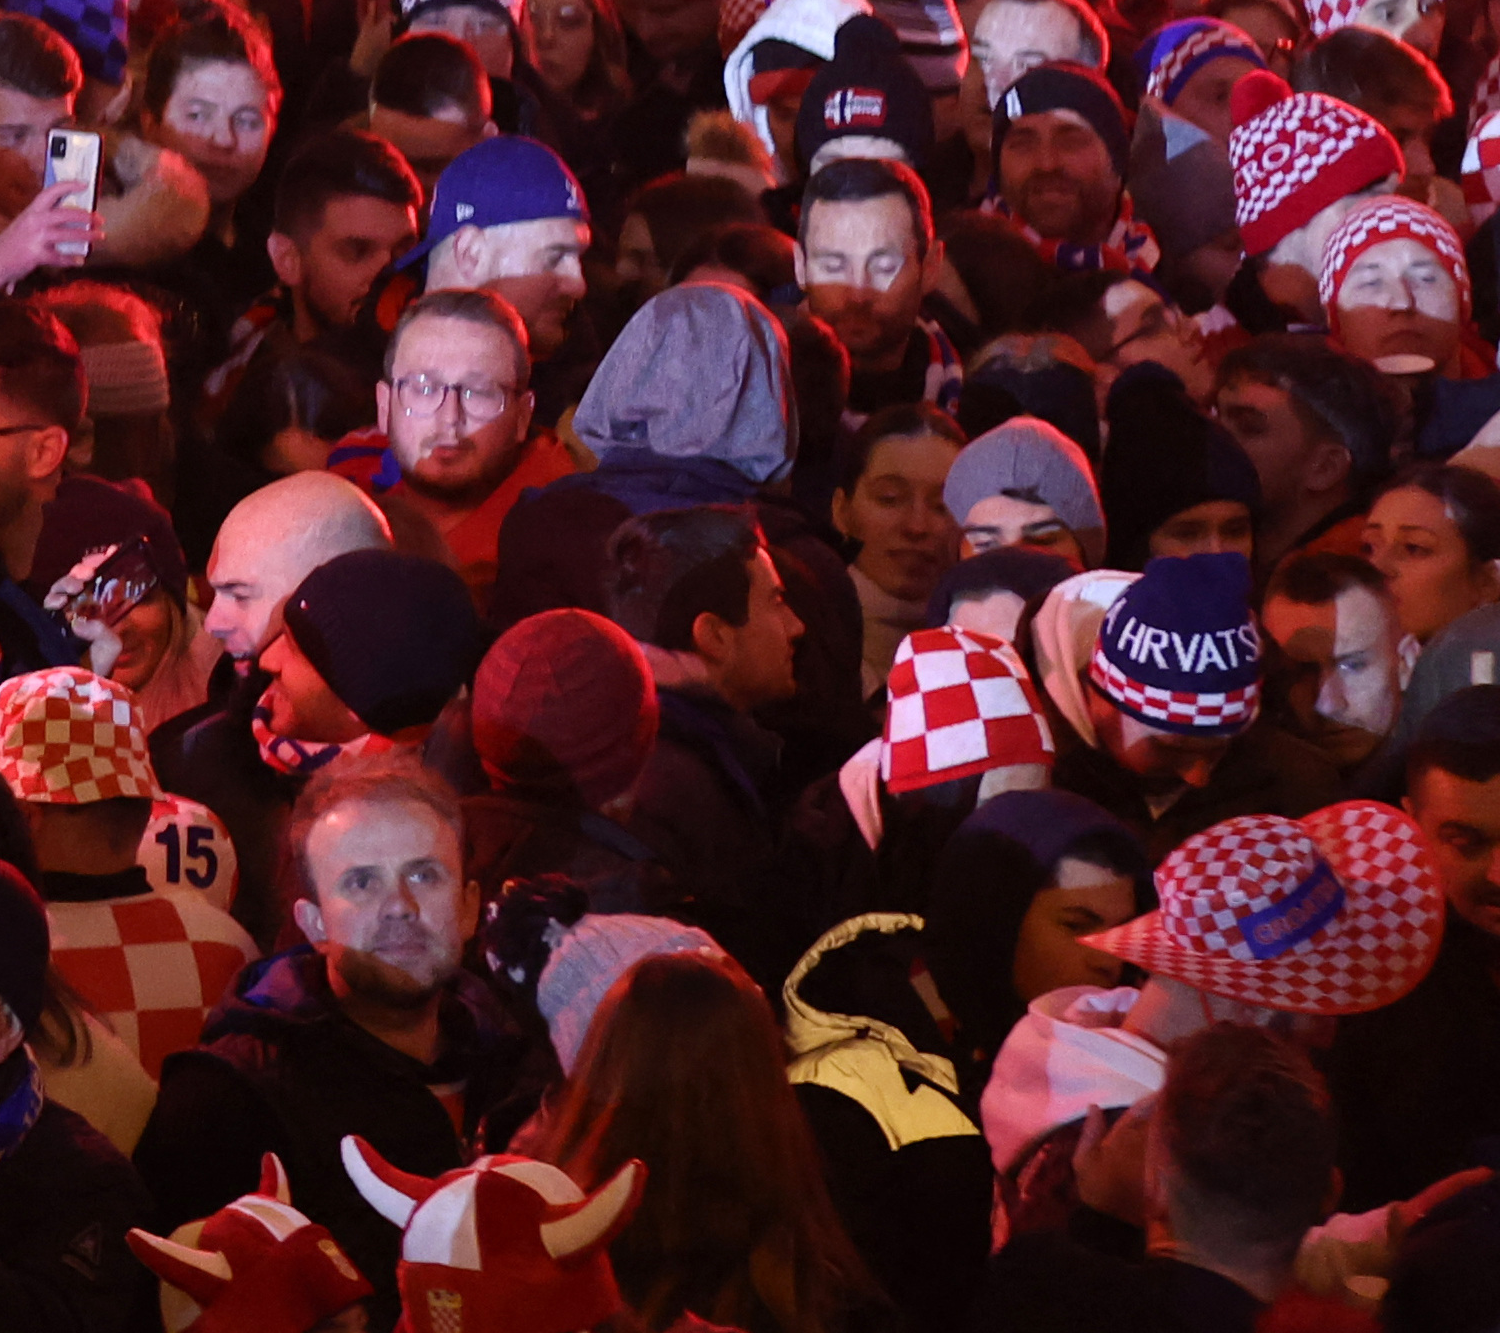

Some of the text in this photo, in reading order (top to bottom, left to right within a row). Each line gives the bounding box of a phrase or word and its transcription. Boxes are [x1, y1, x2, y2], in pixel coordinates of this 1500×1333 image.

[1233, 106, 1357, 198] CROATI
[1117, 614, 1262, 674] HRVATS
[155, 822, 218, 890] 15
